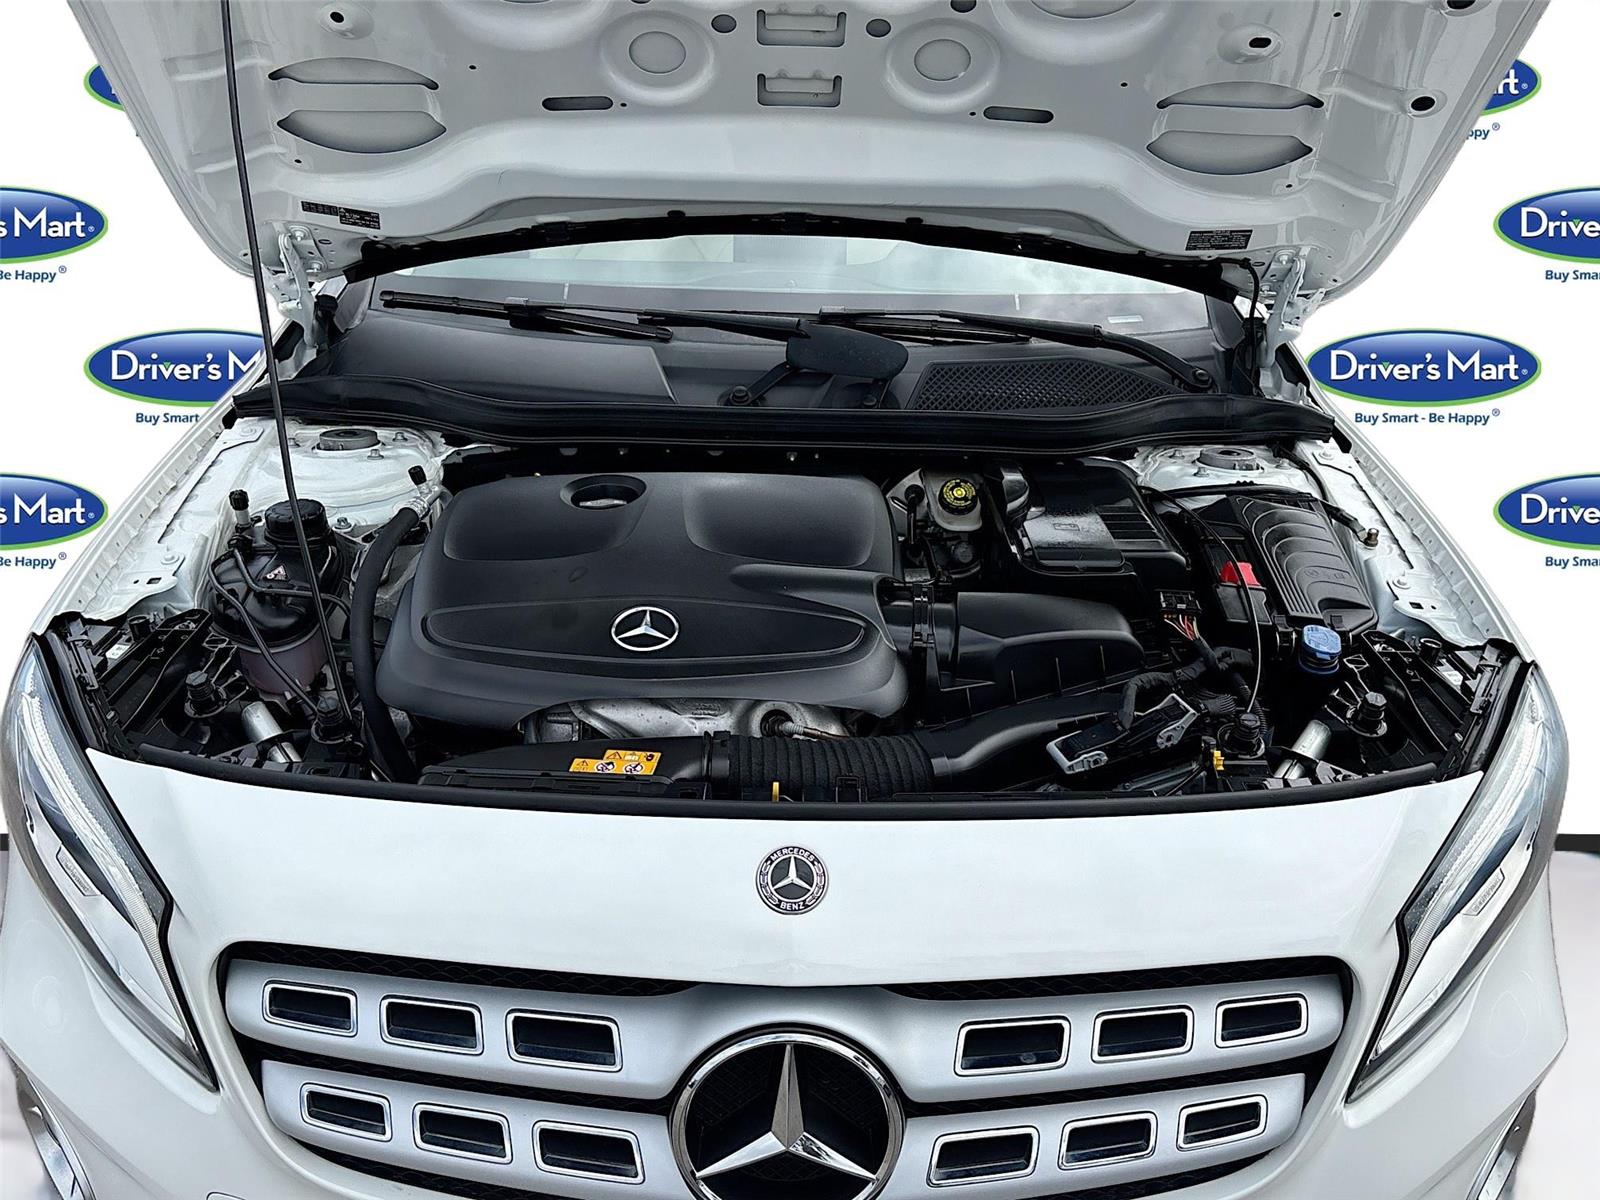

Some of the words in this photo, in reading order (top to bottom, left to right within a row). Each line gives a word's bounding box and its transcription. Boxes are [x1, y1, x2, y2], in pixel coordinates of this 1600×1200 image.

[1495, 69, 1519, 94] rt
[14, 206, 86, 238] Mart
[15, 270, 57, 283] Happy
[1545, 270, 1569, 283] Buy
[111, 350, 222, 380] Driver's
[1330, 350, 1441, 380] Driver's
[1447, 350, 1519, 380] Mart
[136, 413, 160, 426] Buy
[163, 413, 200, 423] Smart
[1355, 413, 1379, 426] Buy
[1382, 413, 1419, 423] Smart
[1429, 413, 1445, 423] Be
[1448, 413, 1490, 426] Happy
[14, 492, 86, 524] Mart
[15, 556, 57, 569] Happy
[1545, 556, 1569, 569] Buy
[770, 847, 815, 862] MERCEDES
[780, 901, 805, 911] BENZ
